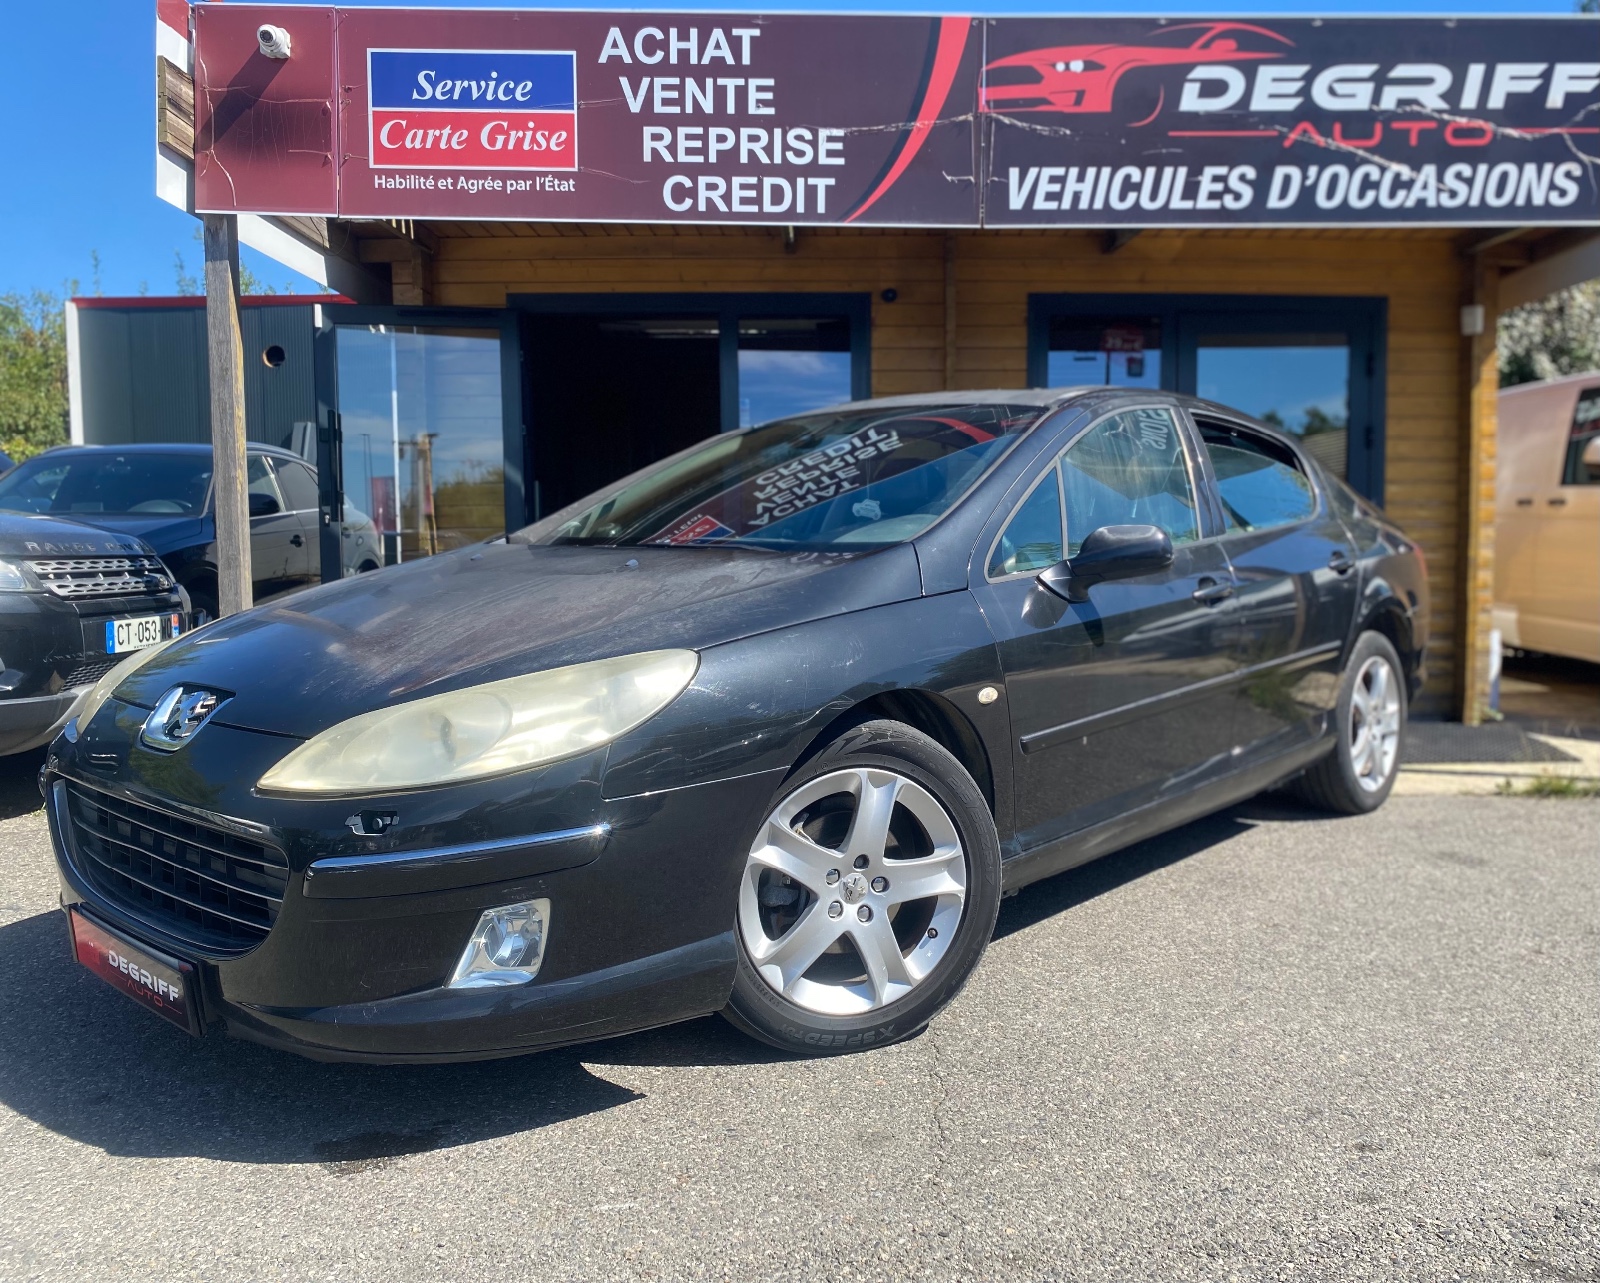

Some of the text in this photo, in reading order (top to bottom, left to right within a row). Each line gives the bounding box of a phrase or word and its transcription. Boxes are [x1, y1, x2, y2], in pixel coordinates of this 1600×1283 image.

[598, 27, 761, 65] ACHAT
[412, 70, 533, 102] Service
[619, 76, 775, 115] VENTE
[1178, 63, 1600, 111] DEGRIFF
[380, 119, 567, 152] Carte Grise
[643, 126, 846, 165] REPRISE
[1283, 121, 1494, 148] AUTO
[374, 174, 434, 190] Habilité
[437, 176, 453, 190] et
[457, 176, 503, 194] Agrée
[506, 178, 532, 194] par
[663, 175, 836, 214] CREDIT
[1008, 164, 1257, 210] VEHICULES
[108, 950, 179, 1002] DEGRIFF
[127, 980, 164, 1007] AUTO
